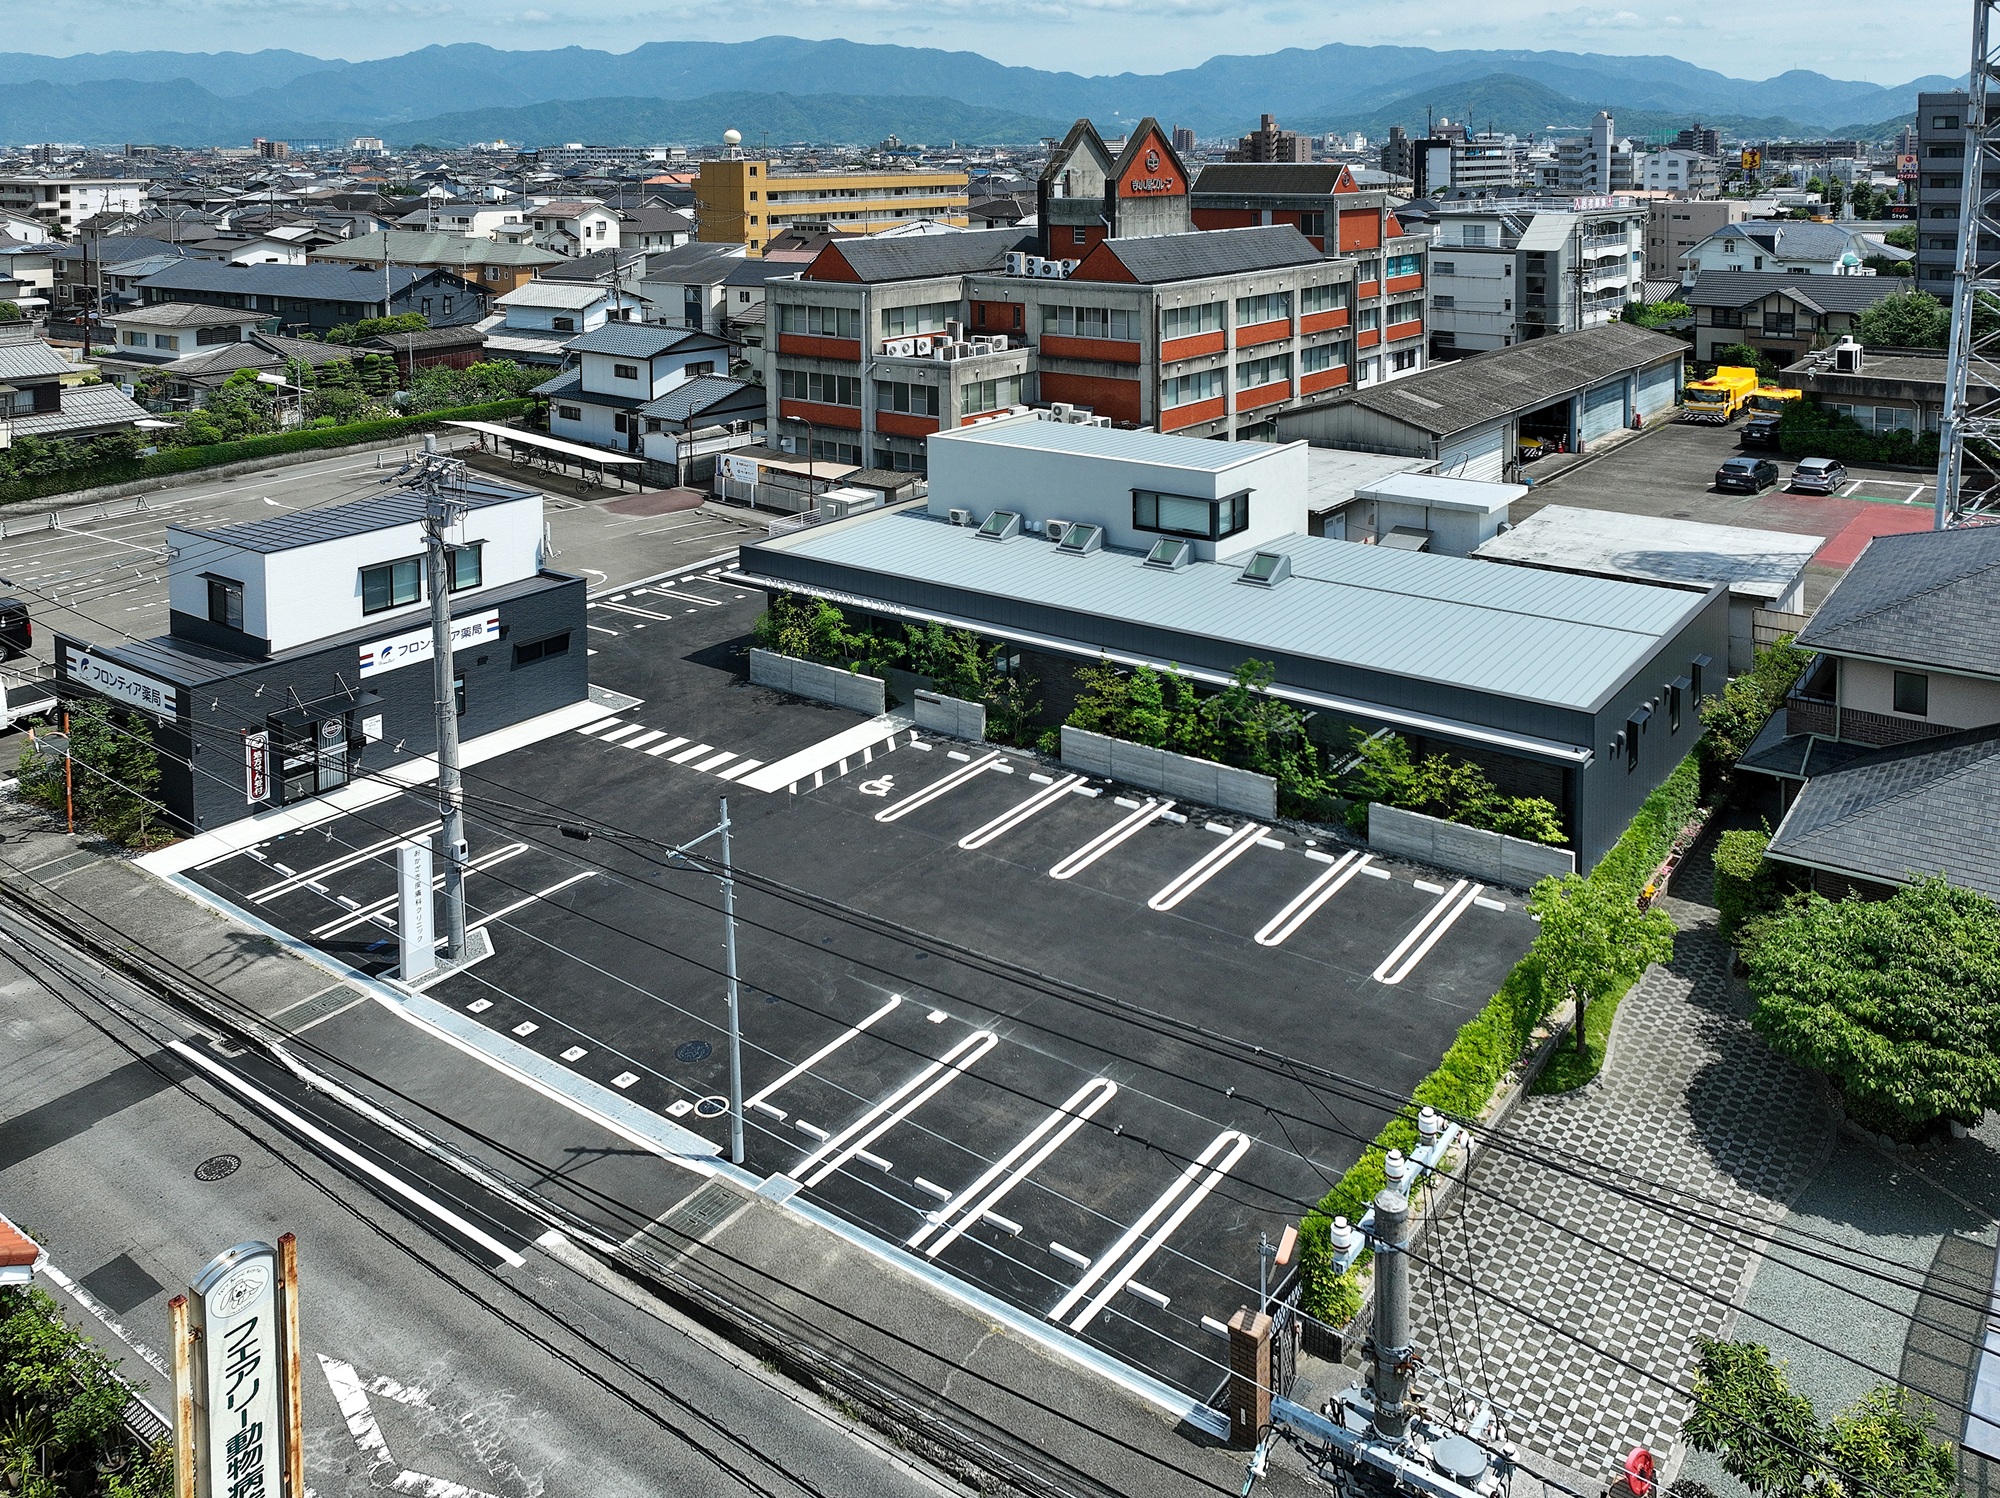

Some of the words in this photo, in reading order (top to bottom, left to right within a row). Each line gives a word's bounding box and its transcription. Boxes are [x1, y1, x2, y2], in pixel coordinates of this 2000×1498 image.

[765, 578, 819, 596] OKAZAKI
[825, 590, 855, 606] SKIN
[398, 623, 483, 657] フロンア薬局
[92, 666, 162, 707] フロンティア薬局
[413, 849, 423, 944] おかざき皮膚科クリニック
